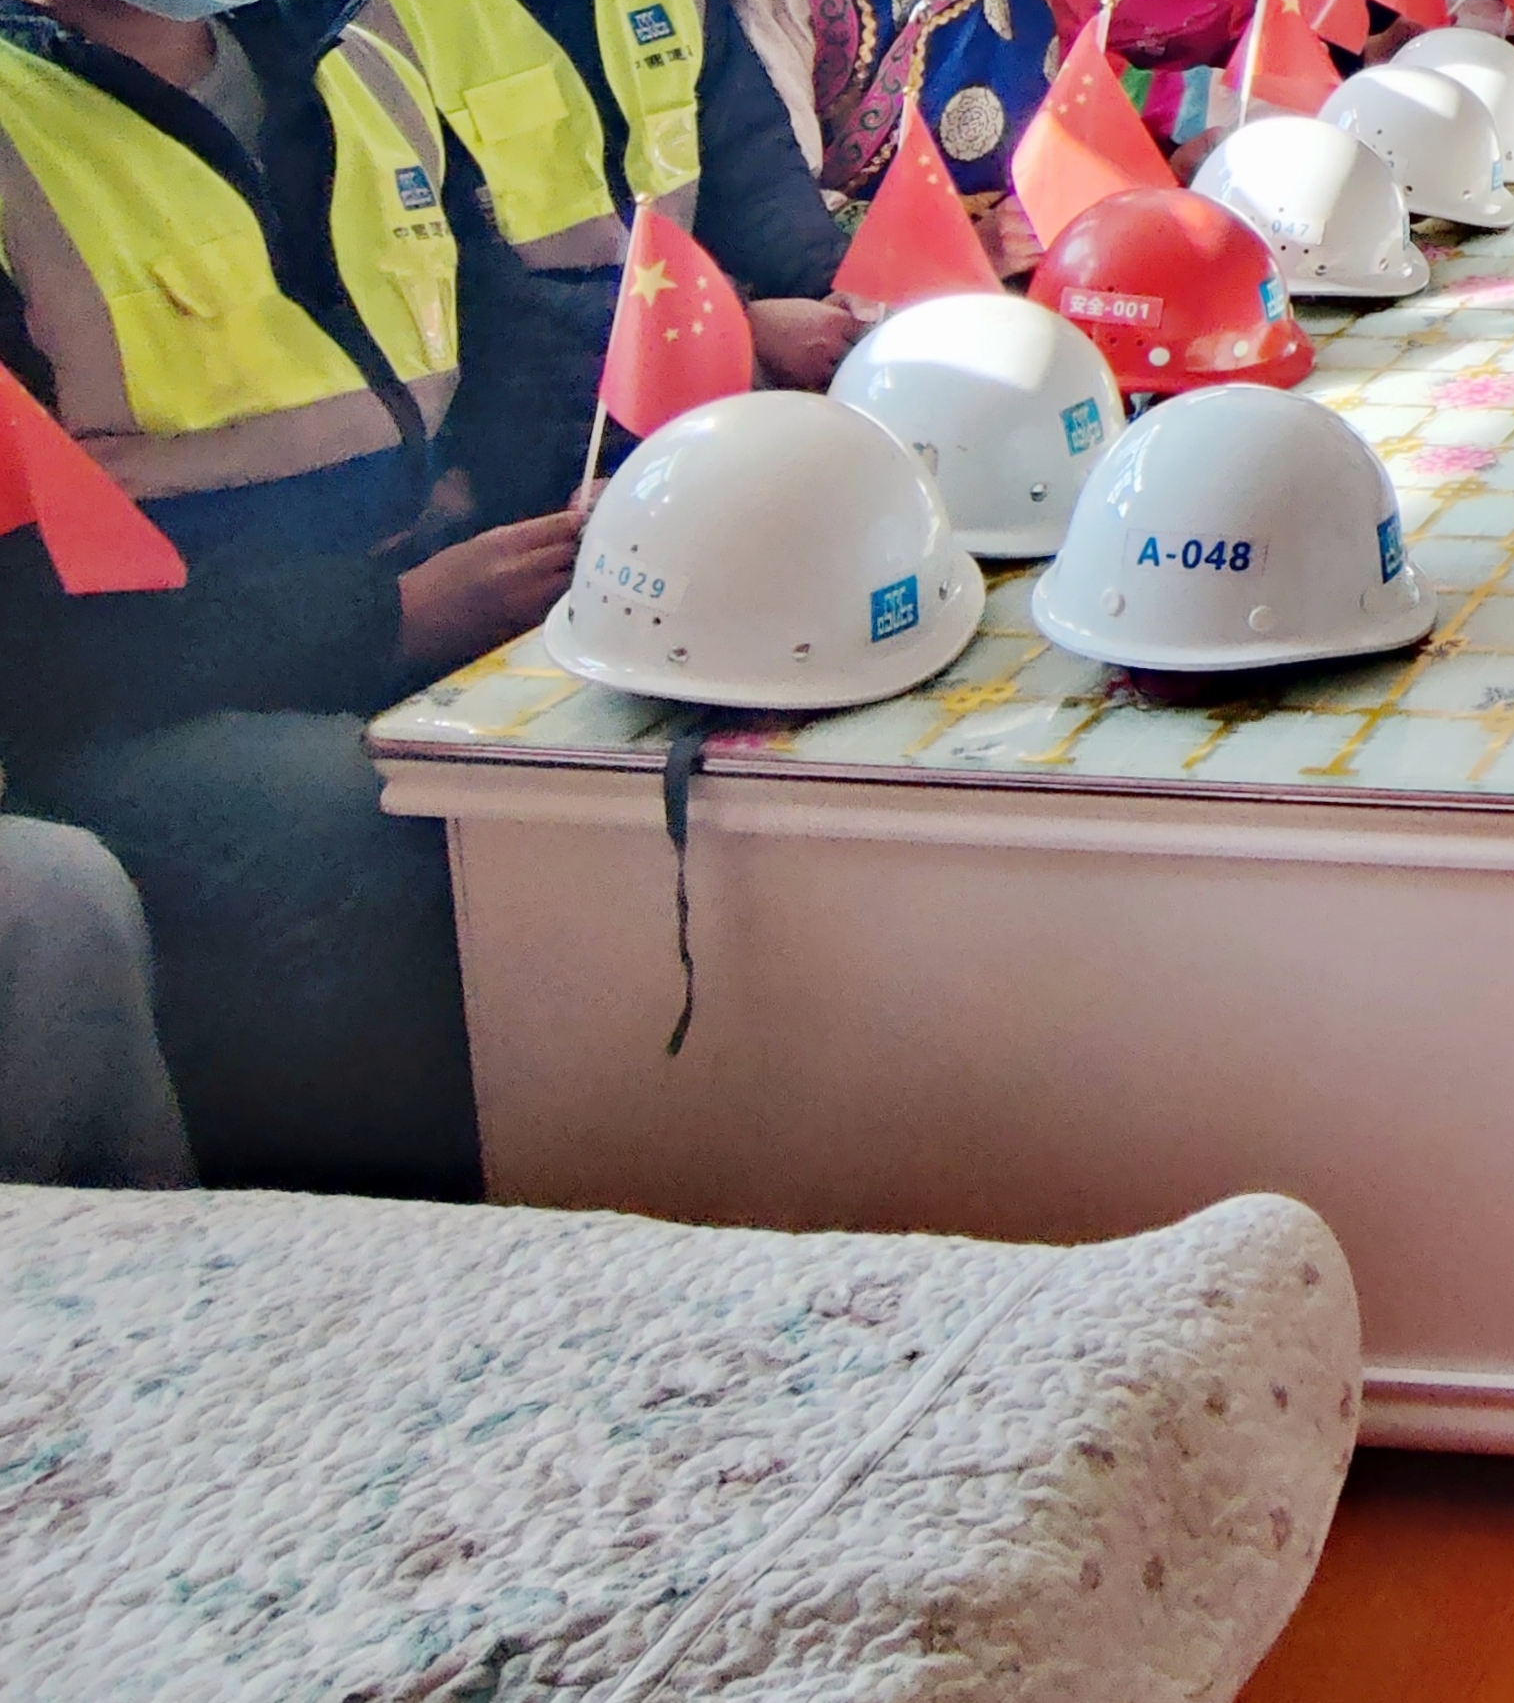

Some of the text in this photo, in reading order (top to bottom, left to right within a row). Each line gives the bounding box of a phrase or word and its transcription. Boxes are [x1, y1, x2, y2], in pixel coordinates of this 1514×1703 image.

[1069, 294, 1151, 320] 安全-001
[1136, 536, 1252, 572] A-048
[594, 553, 667, 600] A-029
